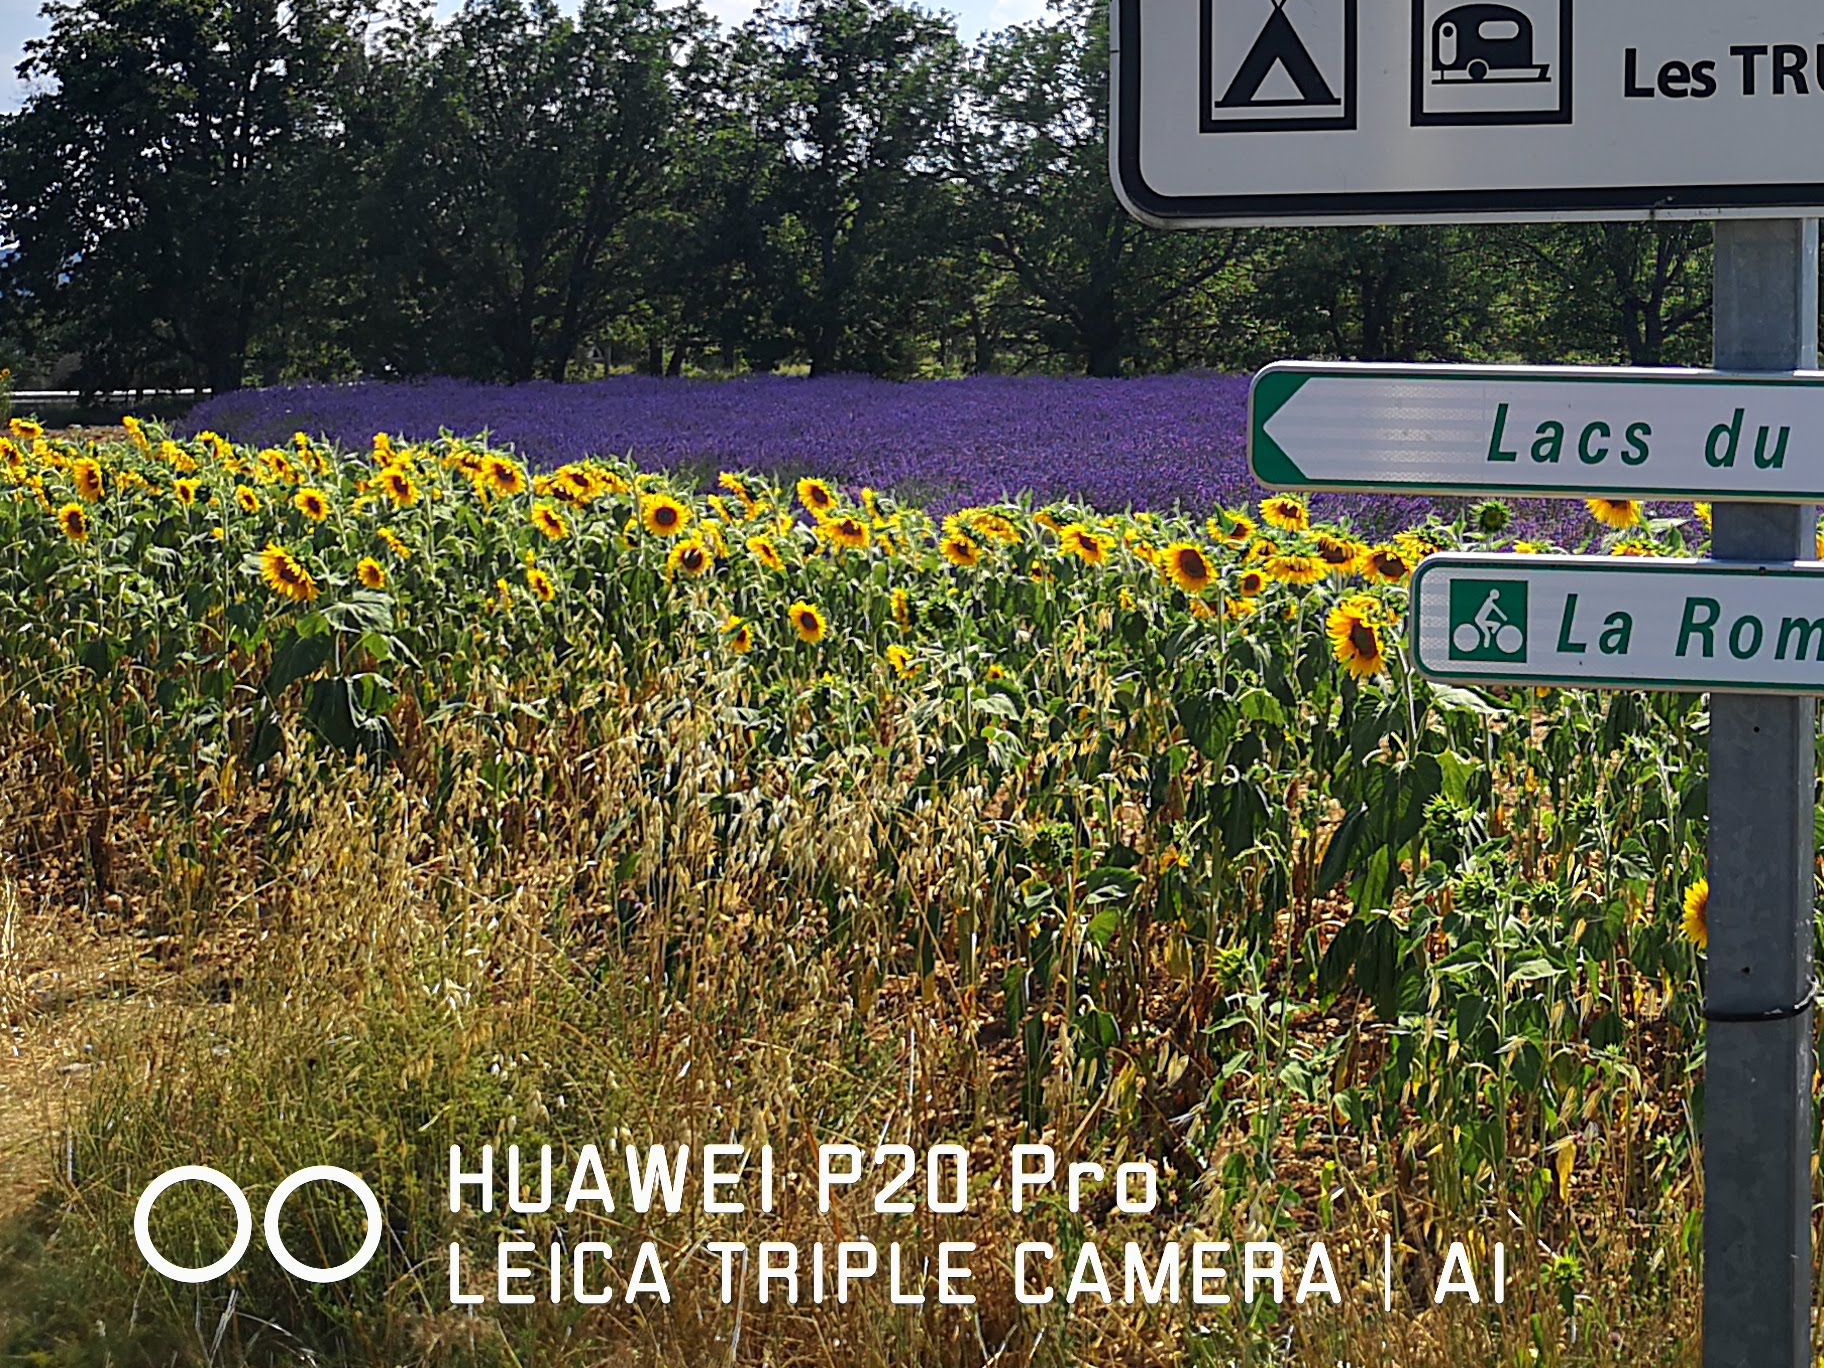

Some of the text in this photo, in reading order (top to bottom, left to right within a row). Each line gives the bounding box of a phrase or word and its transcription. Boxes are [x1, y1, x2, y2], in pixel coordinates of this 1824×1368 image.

[1624, 48, 1716, 98] Les
[1487, 403, 1651, 465] Lacs
[1705, 408, 1790, 469] du
[1557, 594, 1632, 654] La
